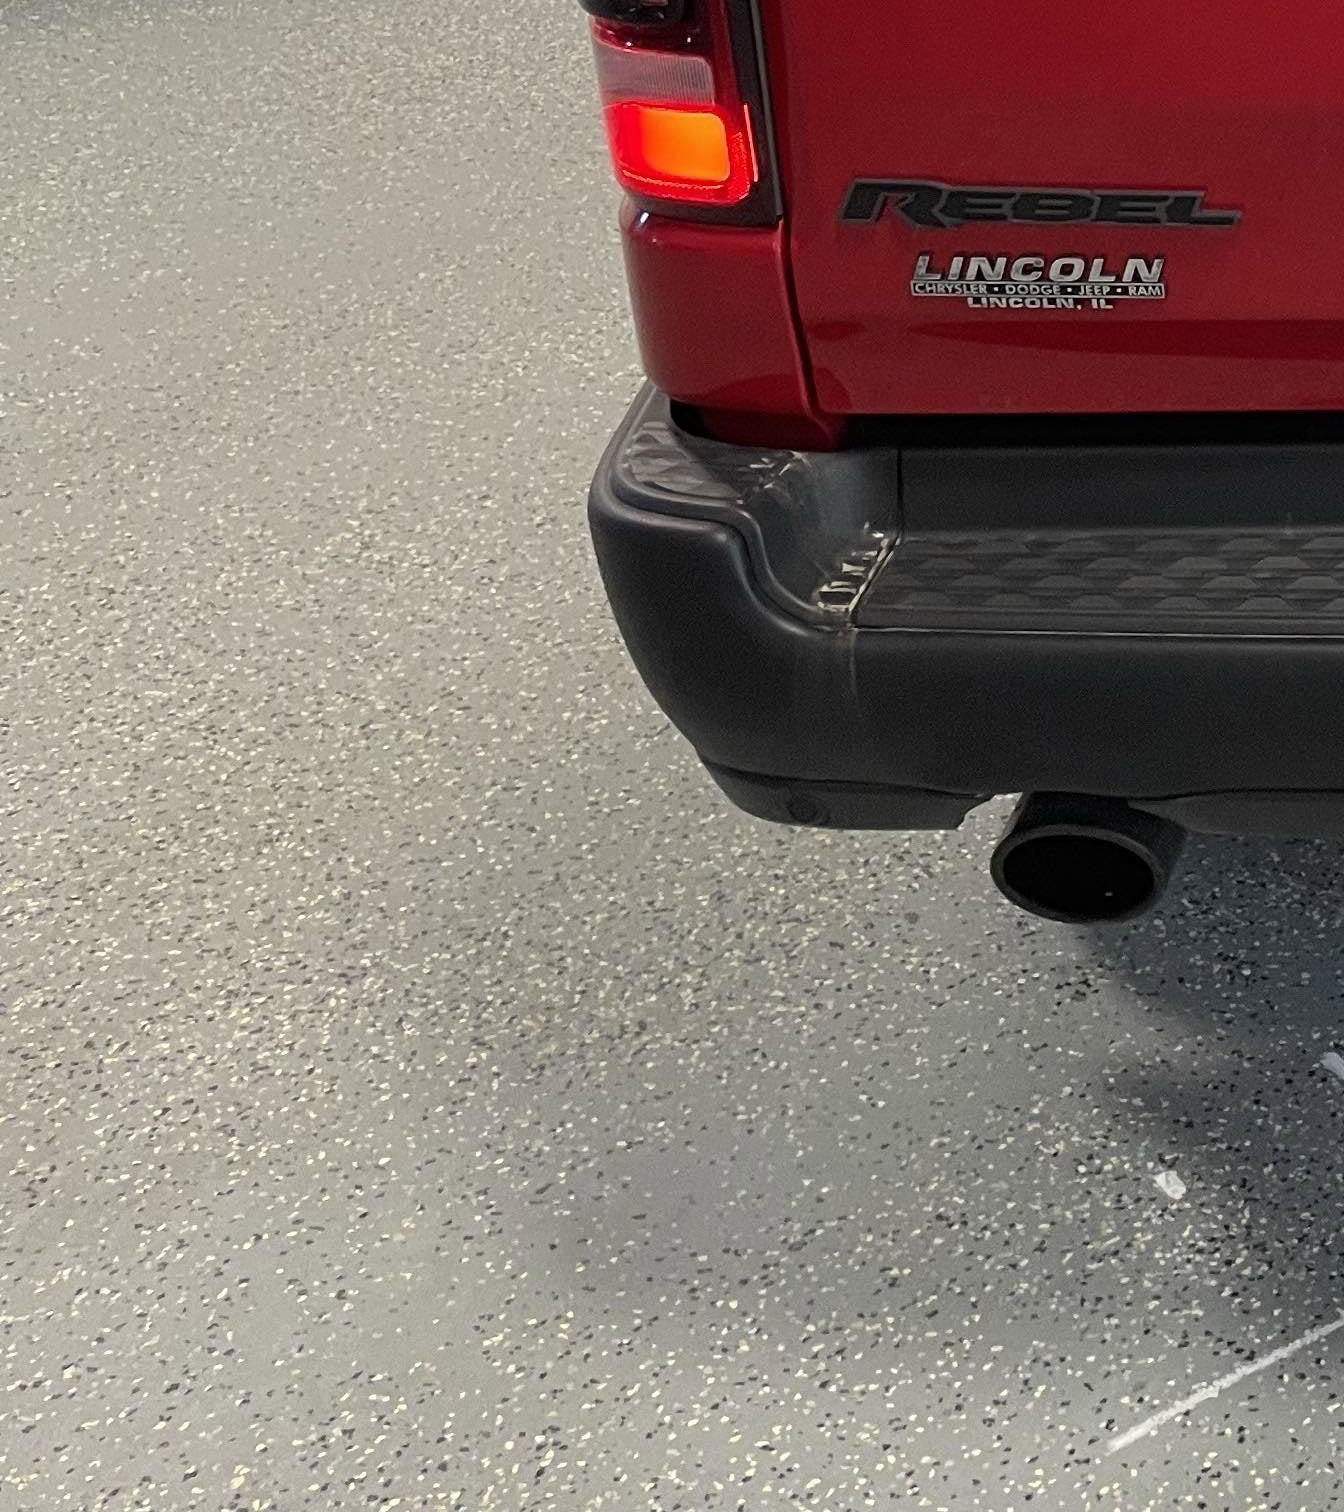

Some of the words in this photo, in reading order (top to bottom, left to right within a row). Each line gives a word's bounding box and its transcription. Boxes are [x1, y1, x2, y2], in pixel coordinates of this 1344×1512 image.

[840, 178, 1242, 230] REBEL
[913, 255, 1165, 284] LINCOLN
[914, 282, 989, 296] CHRYSLER
[1005, 285, 1061, 297] DODGE
[1078, 285, 1111, 297] JEEP
[1128, 286, 1162, 298] RAM
[967, 296, 1083, 311] LINCOLN,
[1092, 296, 1114, 311] IL
